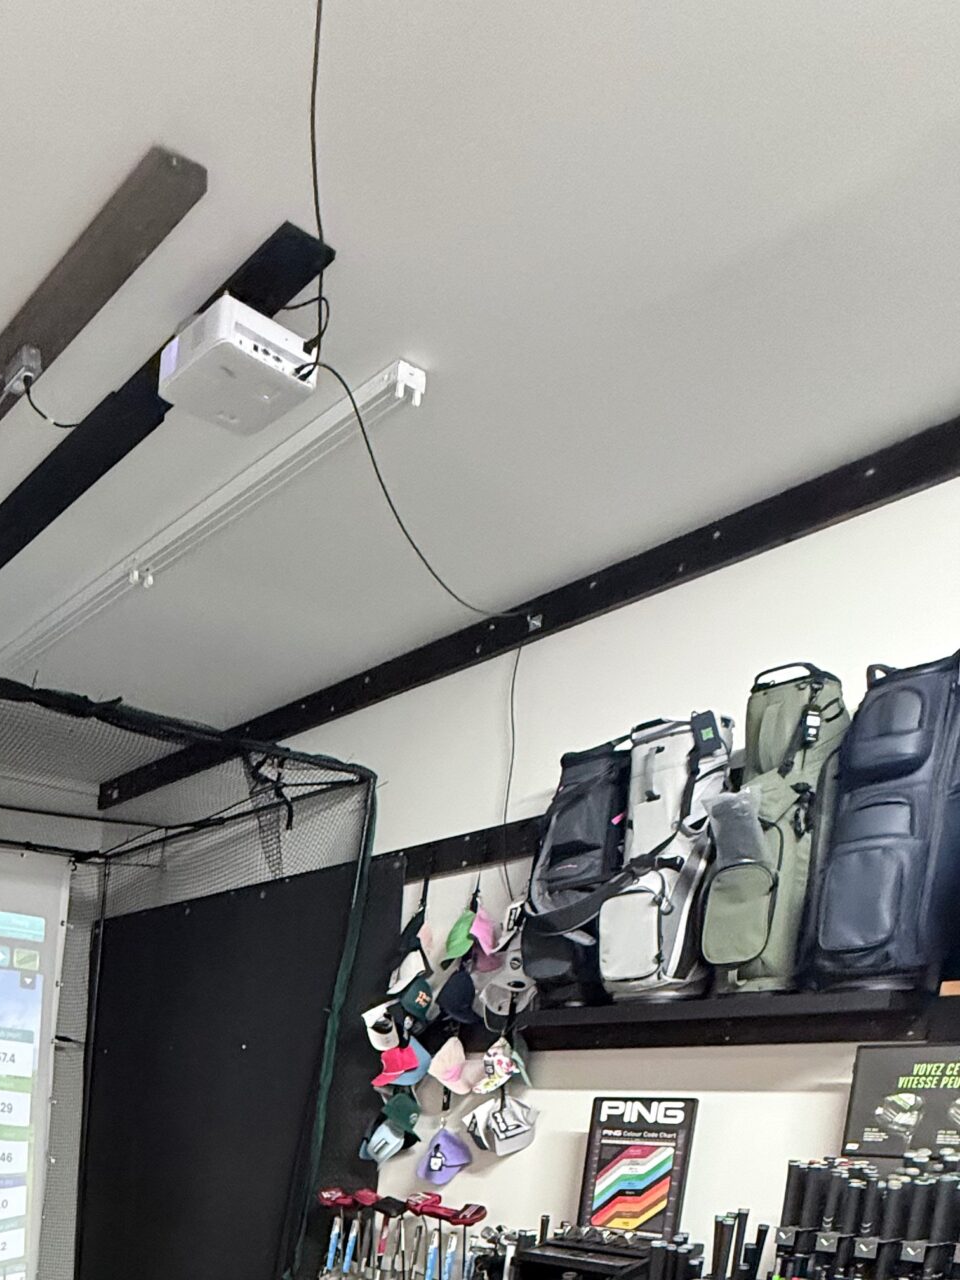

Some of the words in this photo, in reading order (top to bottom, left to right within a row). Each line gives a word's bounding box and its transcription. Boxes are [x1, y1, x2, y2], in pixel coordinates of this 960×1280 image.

[912, 1063, 945, 1075] VOYEZ
[897, 1076, 939, 1088] VITESSE
[599, 1100, 685, 1125] PING
[602, 1129, 622, 1137] PING
